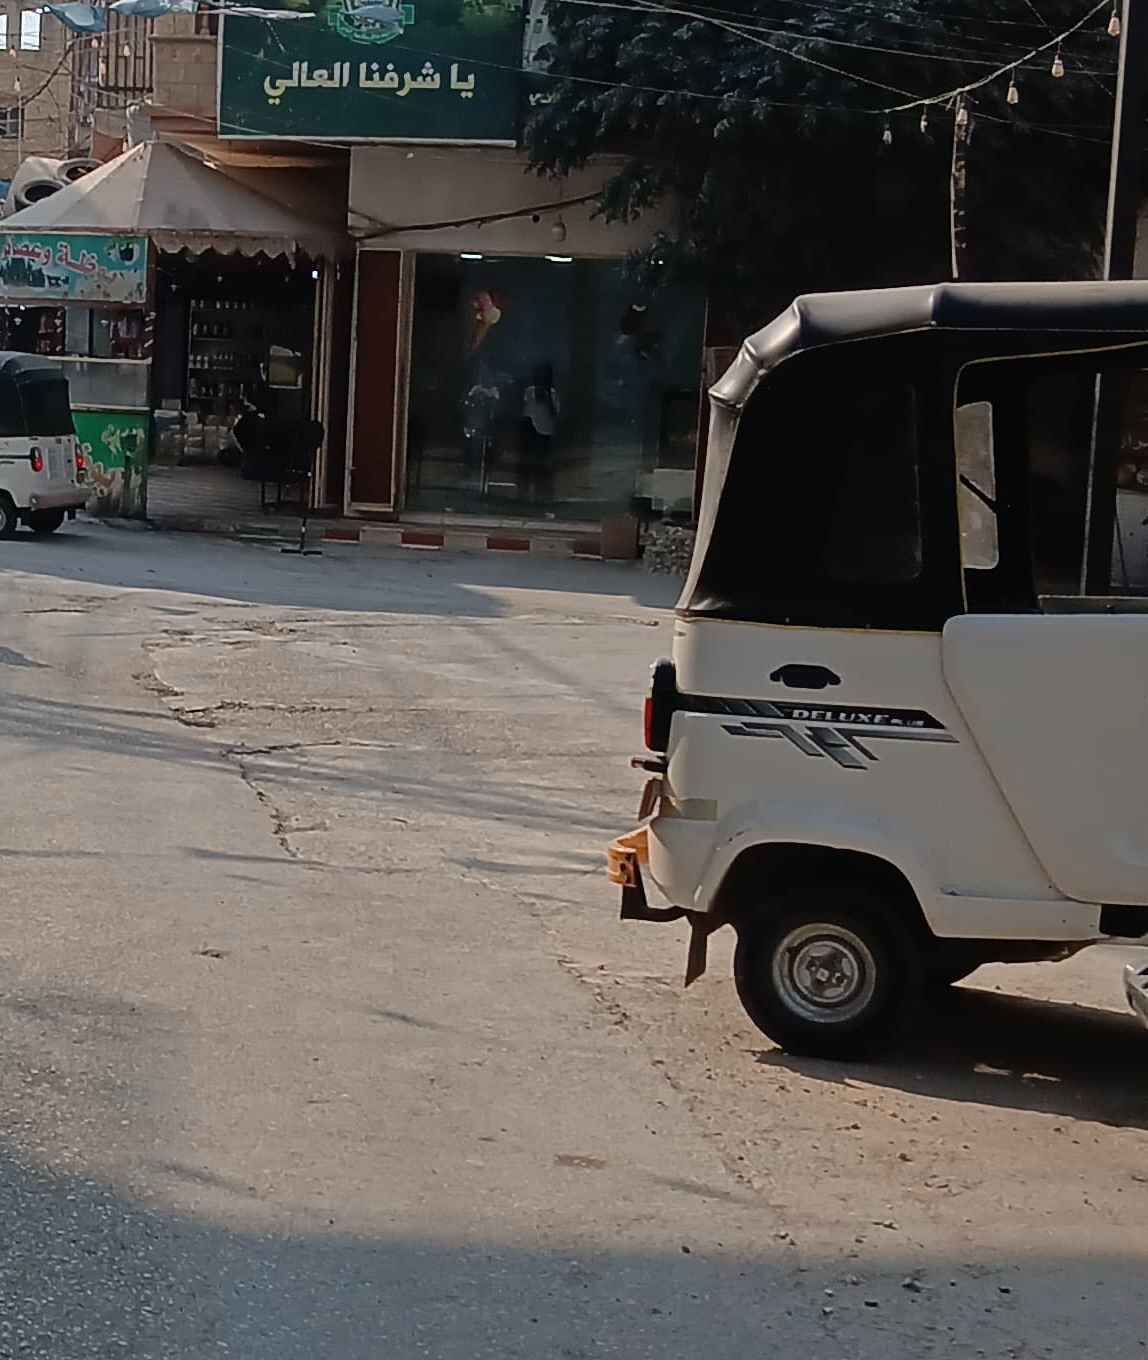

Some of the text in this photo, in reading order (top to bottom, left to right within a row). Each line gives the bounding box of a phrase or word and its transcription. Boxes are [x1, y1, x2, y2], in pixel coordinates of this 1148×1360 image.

[263, 61, 475, 105] يا شرفنا العالي
[792, 709, 889, 725] DELUXE
